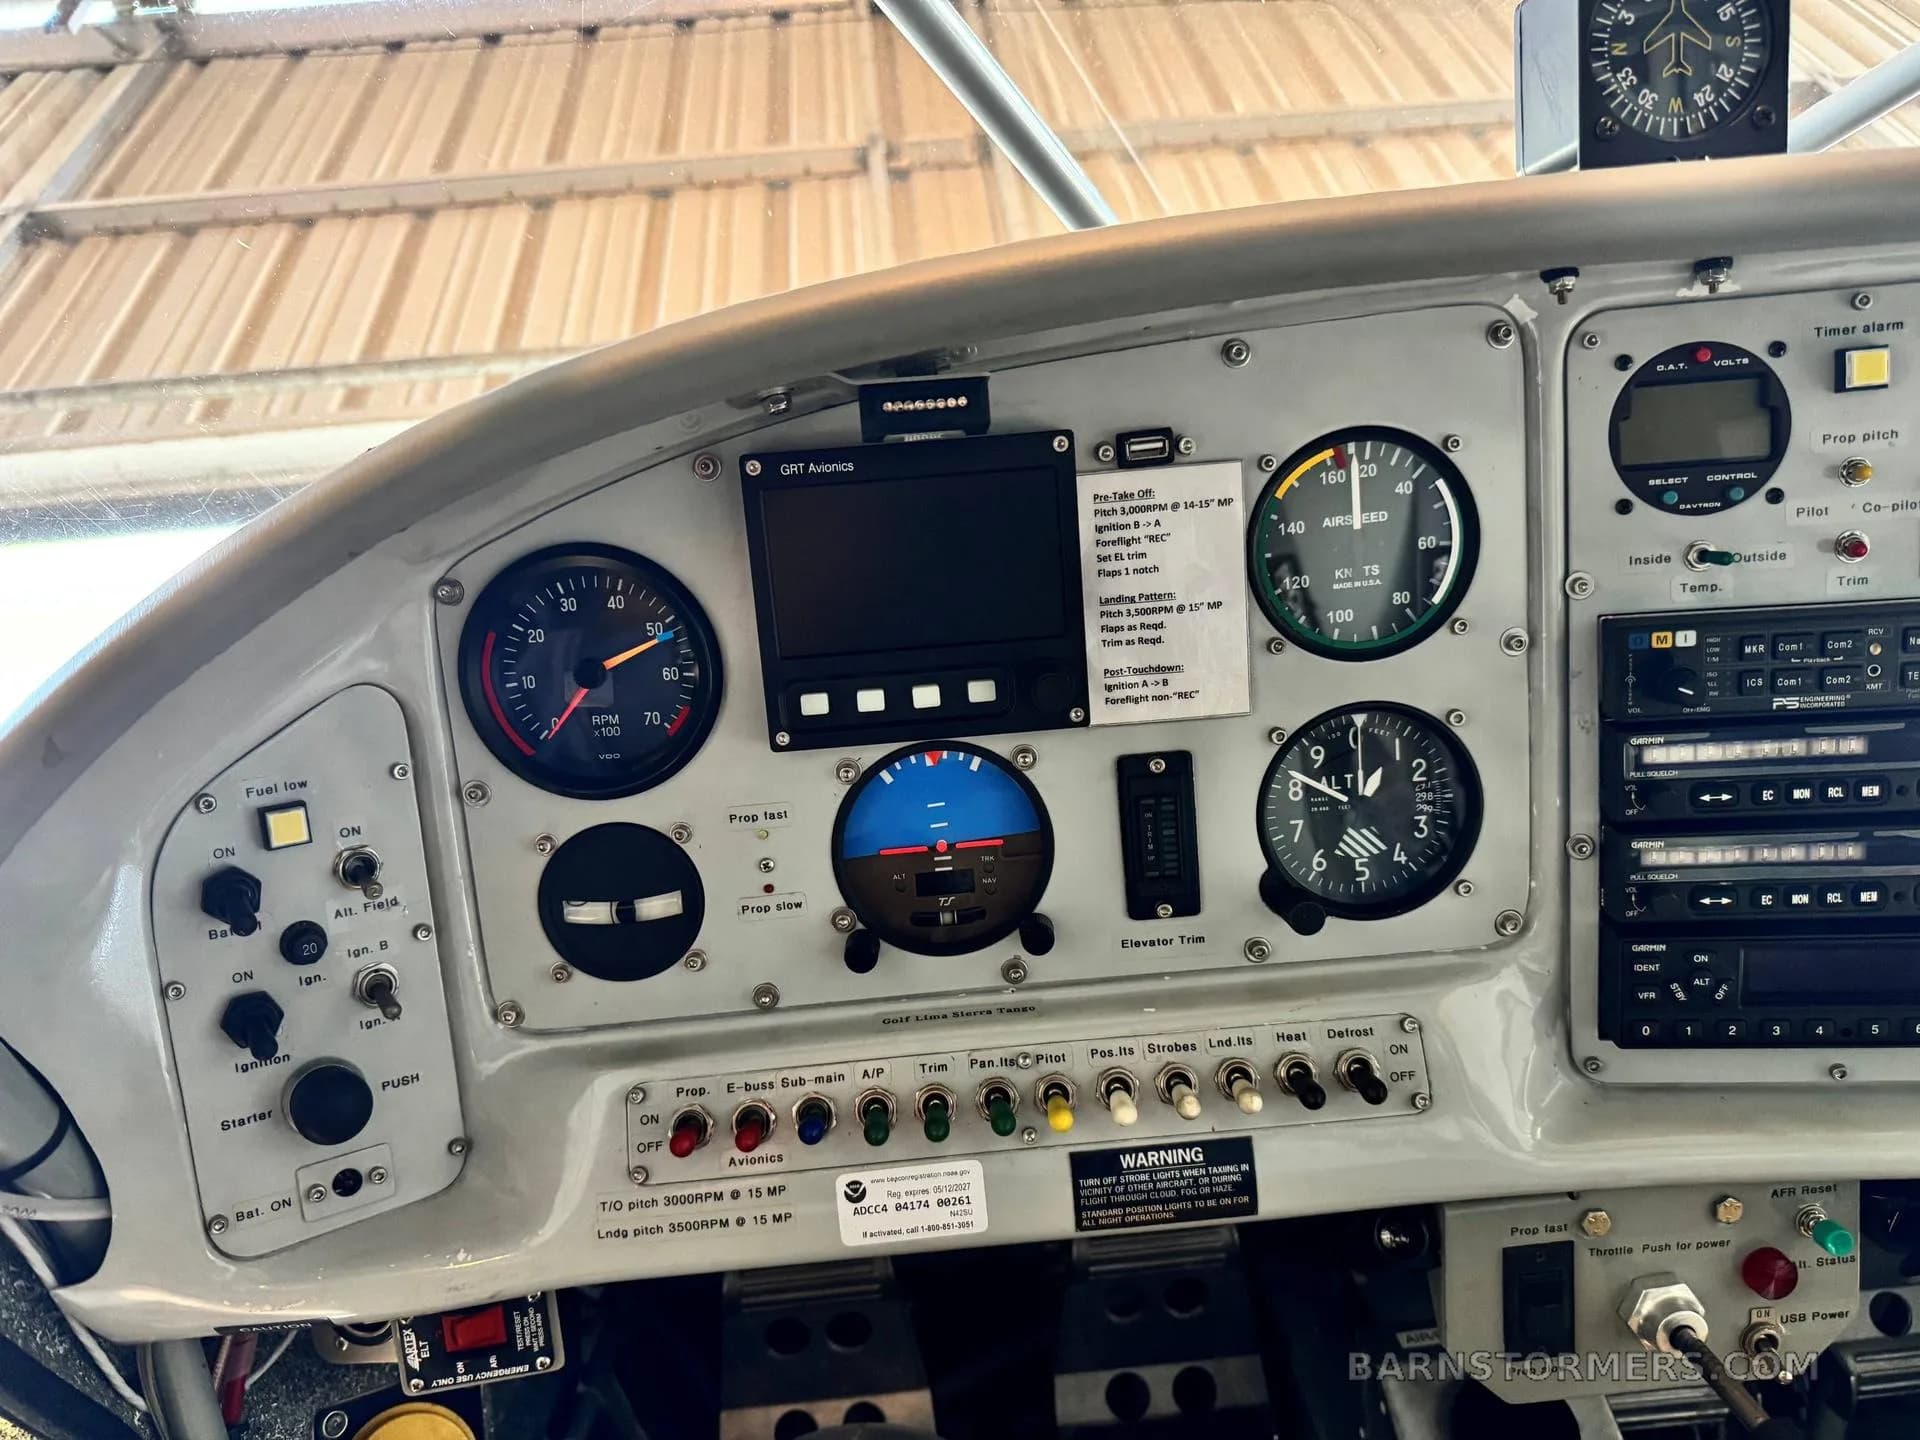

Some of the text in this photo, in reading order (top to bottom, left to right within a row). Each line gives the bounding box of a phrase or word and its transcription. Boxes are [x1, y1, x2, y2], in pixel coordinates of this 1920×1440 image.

[1725, 35, 1741, 48] S
[1611, 42, 1627, 55] N
[1638, 88, 1658, 109] 30
[1693, 86, 1715, 107] 24
[1668, 99, 1683, 112] W
[1814, 320, 1904, 338] Timer alarm
[1656, 362, 1688, 371] O.A.T.
[1713, 357, 1749, 367] VOLTS
[1822, 428, 1899, 446] Prop pitch
[780, 460, 854, 476] GRT Avionics
[1320, 471, 1346, 484] 160
[1648, 476, 1688, 485] SELECT
[1706, 472, 1758, 482] CONTROL
[1395, 481, 1413, 495] 40
[1093, 488, 1155, 503] Pre-Take Off:
[1094, 508, 1117, 518] Pitch
[1120, 503, 1168, 516] 3,000RPM
[1171, 503, 1180, 512] @
[1217, 498, 1234, 507] MP
[1795, 506, 1828, 518] Pilot
[1278, 520, 1305, 536] 140
[1418, 536, 1436, 549] 60
[1629, 550, 1787, 566] Inside Outside
[1098, 564, 1159, 579] Flaps 1 notch
[1283, 575, 1309, 590] 120
[1680, 581, 1723, 594] Temp.
[1837, 575, 1869, 588] Trim
[607, 596, 625, 610] 40
[1099, 592, 1176, 605] Landing Pattern:
[1392, 591, 1410, 605] 80
[560, 598, 577, 612] 30
[1327, 609, 1354, 623] 100
[527, 629, 545, 643] 20
[1744, 643, 1765, 653] MKR
[1778, 642, 1803, 652] Com1
[1827, 640, 1852, 649] Com2
[662, 667, 679, 681] 60
[1104, 664, 1184, 677] Post-Touchdown:
[522, 676, 536, 689] 10
[592, 714, 619, 725] RPM
[644, 712, 661, 725] 70
[1630, 737, 1664, 745] GARMIN
[1310, 746, 1325, 768] 9
[1412, 759, 1427, 781] 2
[246, 779, 308, 799] Fuel low
[1793, 789, 1810, 799] MON
[1828, 787, 1844, 798] RCL
[1861, 785, 1880, 796] MEM
[729, 809, 788, 825] Prop fast
[339, 826, 362, 838] ON
[1290, 820, 1304, 842] 7
[1414, 815, 1428, 838] 3
[213, 847, 235, 859] ON
[1393, 842, 1407, 864] 4
[1312, 849, 1326, 871] 6
[1355, 858, 1370, 881] 5
[334, 896, 399, 919] Alt. Field
[741, 899, 803, 915] Prop slow
[1121, 934, 1205, 949] Elevator Trim
[302, 943, 318, 955] 20
[1693, 955, 1708, 963] ON
[1634, 964, 1660, 972] IDENT
[232, 971, 254, 983] ON
[1693, 978, 1710, 986] ALT
[1638, 992, 1656, 1000] VFR
[882, 1005, 1036, 1025] Golf Lima Sierra Tango
[1327, 1026, 1374, 1039] Defrost
[1728, 1026, 1736, 1035] 2
[1773, 1026, 1780, 1035] 3
[1815, 1025, 1823, 1035] 4
[1871, 1025, 1879, 1034] 5
[1276, 1031, 1307, 1043] Heat
[1147, 1041, 1197, 1054] Strobes
[1389, 1043, 1408, 1055] ON
[1036, 1051, 1066, 1064] Pitot
[862, 1066, 885, 1080] A/P
[919, 1061, 948, 1074] Trim
[381, 1073, 420, 1090] PUSH
[780, 1072, 845, 1088] Sub-main
[1389, 1071, 1416, 1083] OFF
[676, 1085, 710, 1098] Prop.
[726, 1081, 775, 1094] E-buss
[221, 1111, 273, 1131] Starter
[639, 1113, 659, 1126] ON
[637, 1141, 663, 1154] OFF
[728, 1152, 784, 1167] Avionics
[1120, 1147, 1204, 1169] WARNING
[1079, 1179, 1100, 1187] TURN
[1103, 1177, 1117, 1185] OFF
[1120, 1174, 1150, 1183] STROBE
[1153, 1170, 1180, 1180] LIGHTS
[1182, 1168, 1206, 1177] WHEN
[1241, 1163, 1249, 1171] IN
[933, 1183, 971, 1194] 05/12/2027
[1771, 1184, 1837, 1199] AFR Reset
[600, 1185, 786, 1212] T/O pitch 3000RPM @ 15 MP
[236, 1198, 292, 1222] Bat. ON
[853, 1196, 971, 1216] ADCC4 04174 00261
[597, 1212, 792, 1239] Lndg pitch 3500RPM @ 15 MP
[906, 1226, 919, 1234] call
[1510, 1222, 1568, 1237] Prop fast
[1588, 1238, 1731, 1257] Throttle Push for power
[1780, 1309, 1850, 1324] USB Power
[475, 1364, 530, 1380] EMERGENCY
[431, 1377, 455, 1388] ONLY
